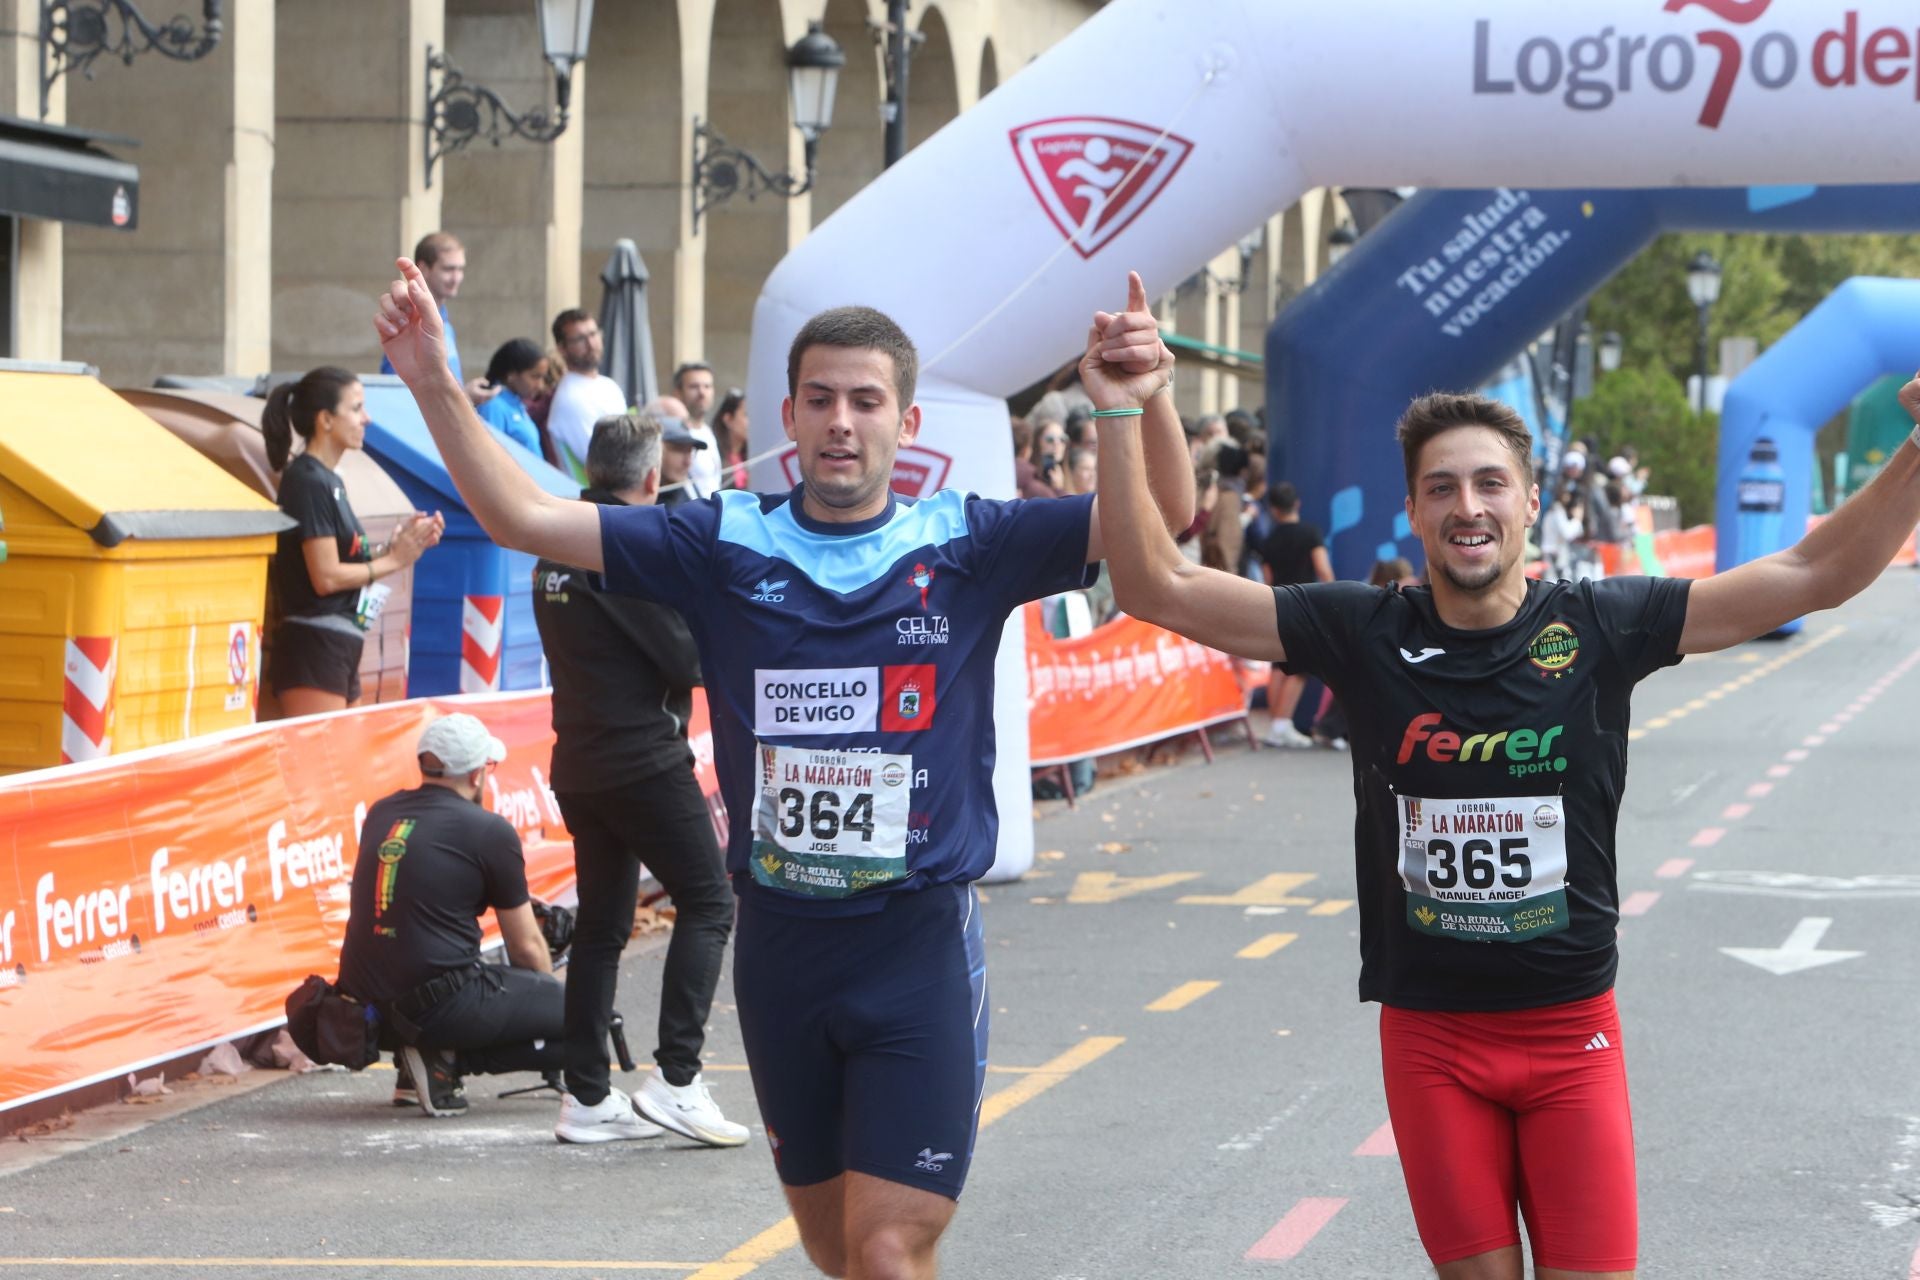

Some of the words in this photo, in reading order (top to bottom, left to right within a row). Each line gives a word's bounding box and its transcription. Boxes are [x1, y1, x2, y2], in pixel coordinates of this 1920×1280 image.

[1812, 11, 1920, 102] de
[1424, 206, 1547, 317] nuestra
[1396, 258, 1445, 294] Tu
[1441, 230, 1571, 336] vocación.
[896, 615, 949, 635] CELTA
[764, 680, 867, 699] CONCELLO
[775, 706, 800, 723] DE
[804, 704, 855, 722] VIGO
[1396, 712, 1564, 765] ferrer
[810, 754, 847, 766] LOGROÑO
[1508, 758, 1552, 778] sport
[785, 763, 800, 783] LA
[805, 765, 872, 787] MARATÓN
[779, 787, 875, 842] 364
[1456, 802, 1496, 813] LOGROÑO
[1431, 814, 1448, 834] LA
[1454, 810, 1524, 834] MARATÓN
[809, 842, 837, 852] JOSE
[1406, 840, 1425, 850] 42K
[807, 866, 843, 878] RURAL
[1427, 837, 1532, 889] 365
[800, 873, 847, 888] NAVARRA
[150, 847, 246, 934] ferrer
[1436, 889, 1485, 901] MANUEL
[1488, 888, 1526, 901] ÁNGEL
[36, 872, 131, 962] ferrer
[1440, 912, 1466, 923] CAJA
[1468, 914, 1504, 926] RURAL
[1513, 905, 1555, 922] ACCIÓN
[1442, 922, 1457, 931] DE
[1459, 923, 1510, 934] NAVARRA
[1514, 917, 1556, 932] SOCIAL
